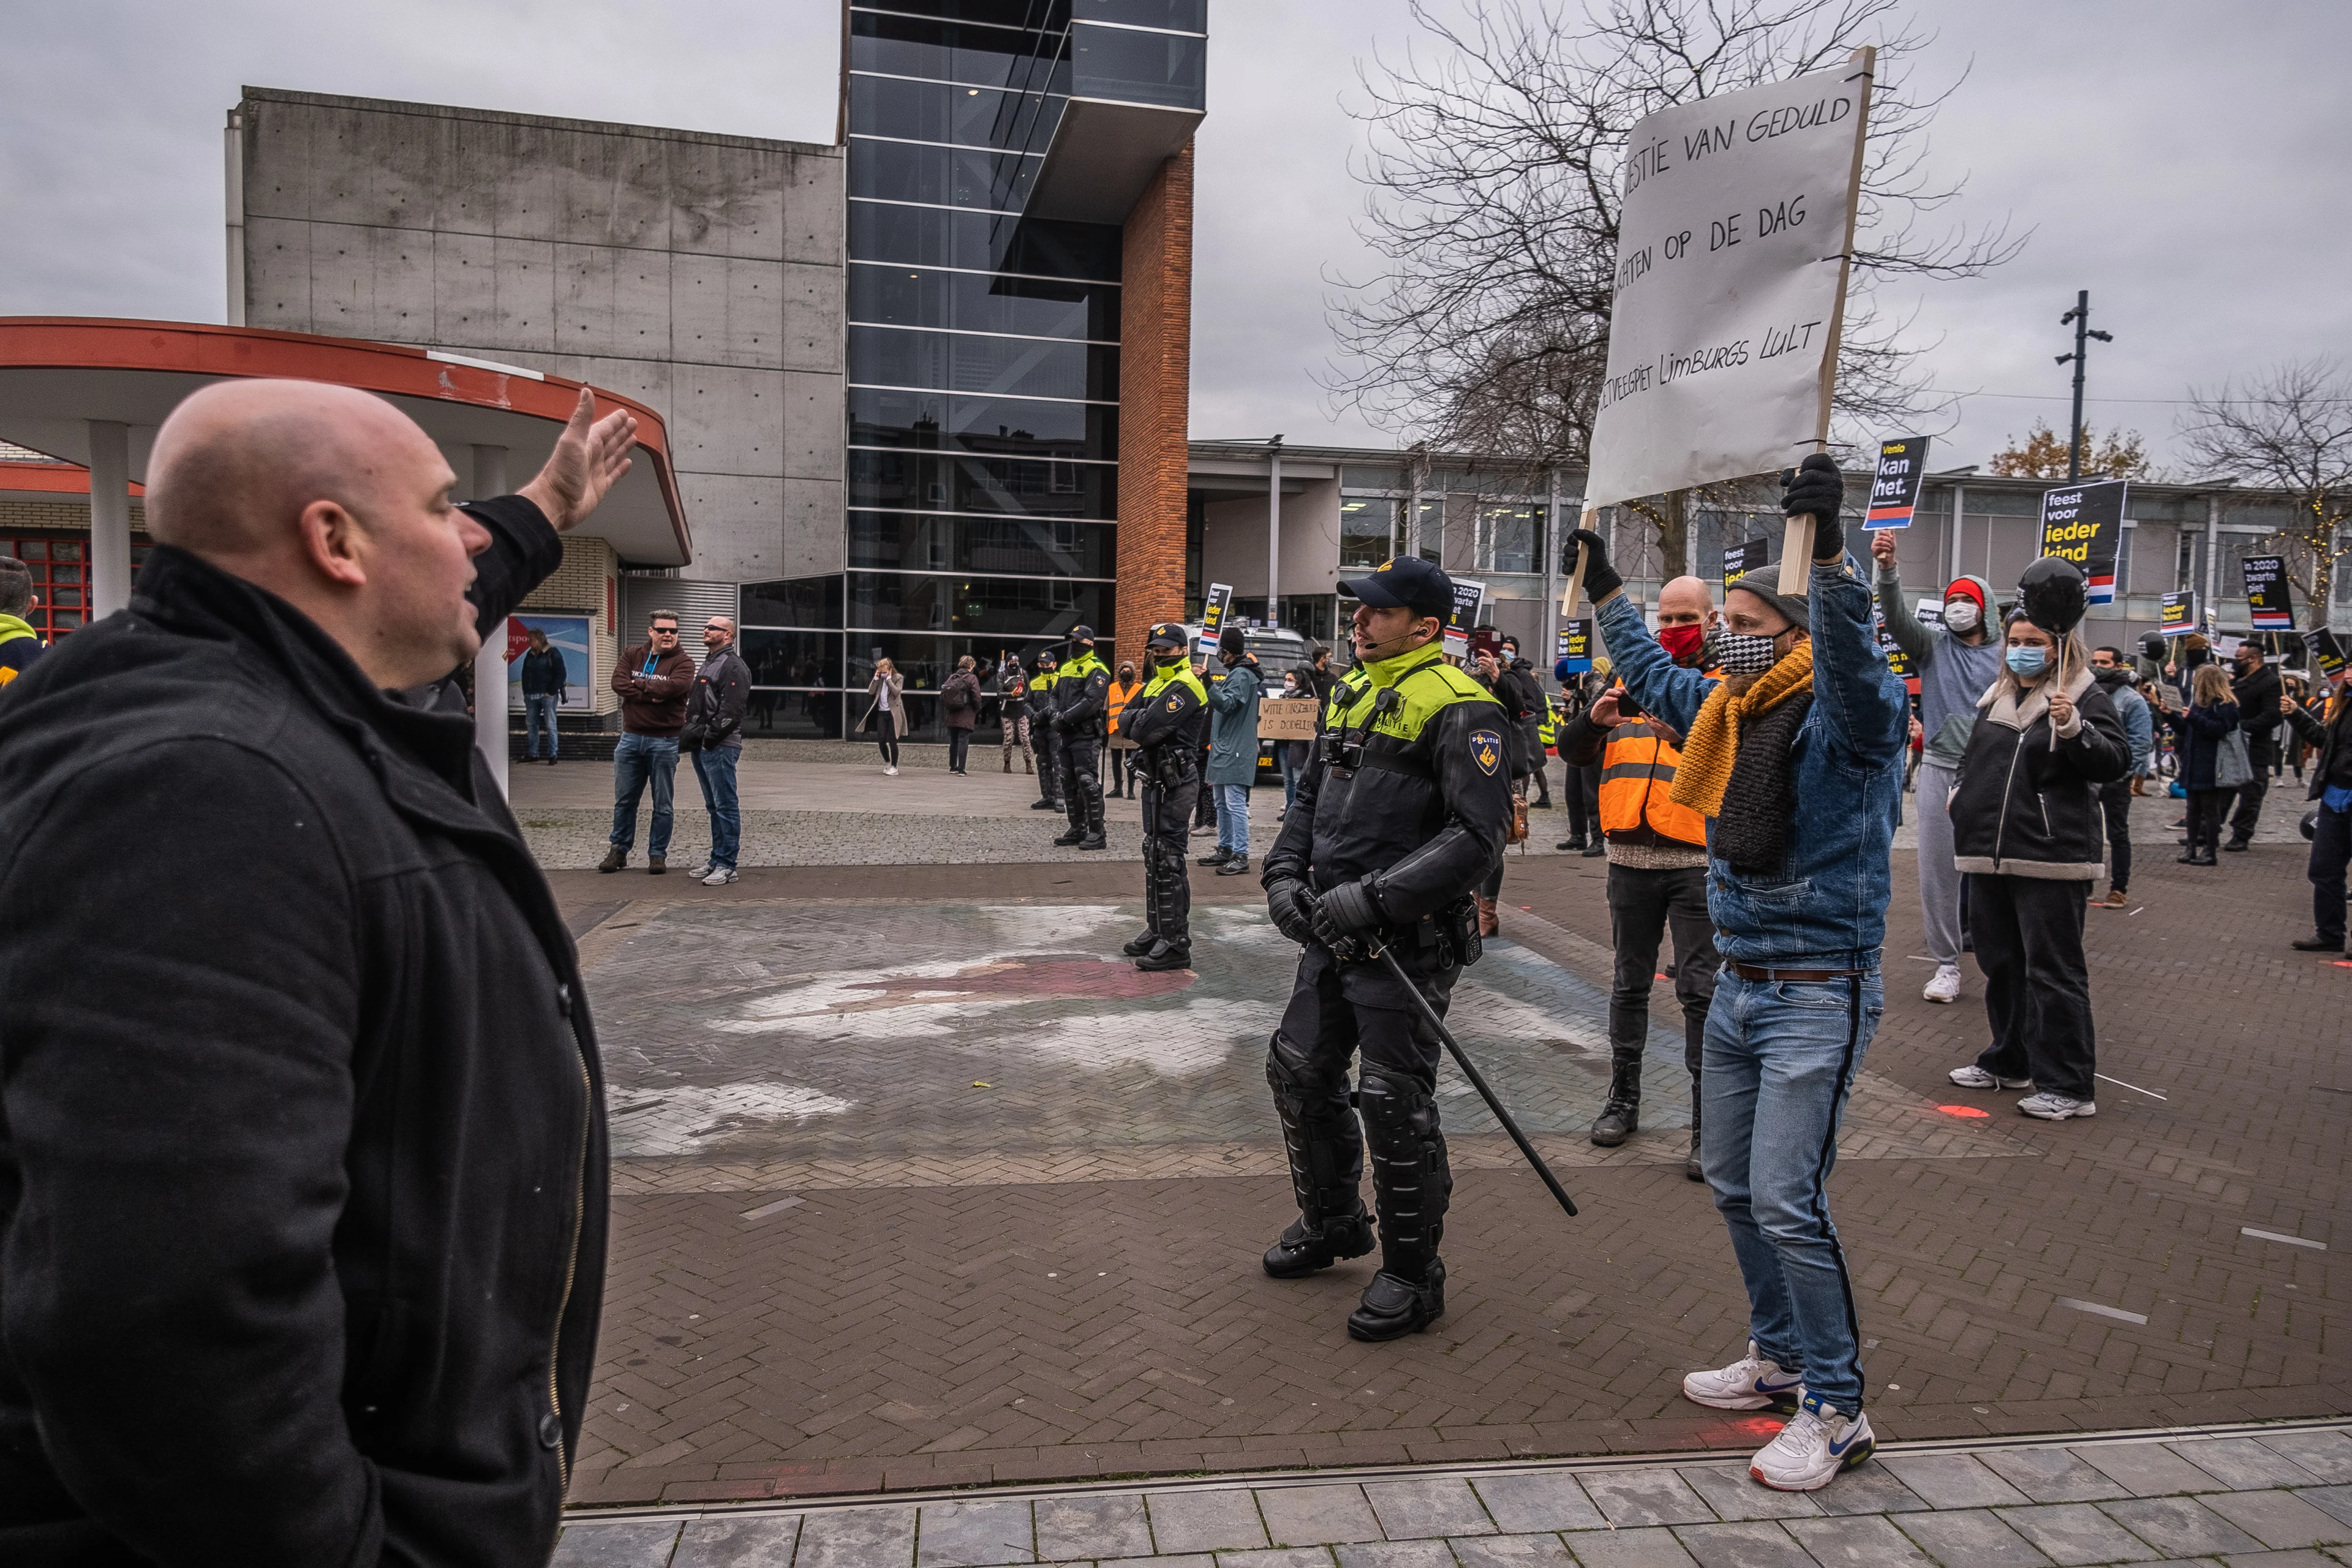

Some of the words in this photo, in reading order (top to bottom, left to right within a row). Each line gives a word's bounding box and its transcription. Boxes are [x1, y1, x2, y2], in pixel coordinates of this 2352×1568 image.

[1625, 137, 1670, 197] ESTIE
[1684, 119, 1735, 161] VAN
[1746, 97, 1851, 142] GEDULD
[1664, 230, 1692, 260] OP
[1710, 213, 1741, 252] DE
[1758, 194, 1806, 238] DAG
[1883, 443, 1905, 454] Venlo
[1879, 457, 1910, 476] kan
[1874, 478, 1907, 497] het.
[2048, 491, 2082, 507] feest
[2047, 508, 2079, 521] voor
[2045, 521, 2101, 543] ieder
[1724, 548, 1745, 560] feest
[1724, 560, 1743, 571] voor
[2253, 560, 2278, 571] 2020
[2246, 572, 2277, 582] zwarte
[1458, 587, 1479, 598] 2020
[2248, 583, 2266, 594] piet
[1207, 604, 1221, 614] ieder
[1205, 614, 1218, 625] kind
[1569, 644, 1583, 654] kind
[1264, 719, 1274, 730] IS
